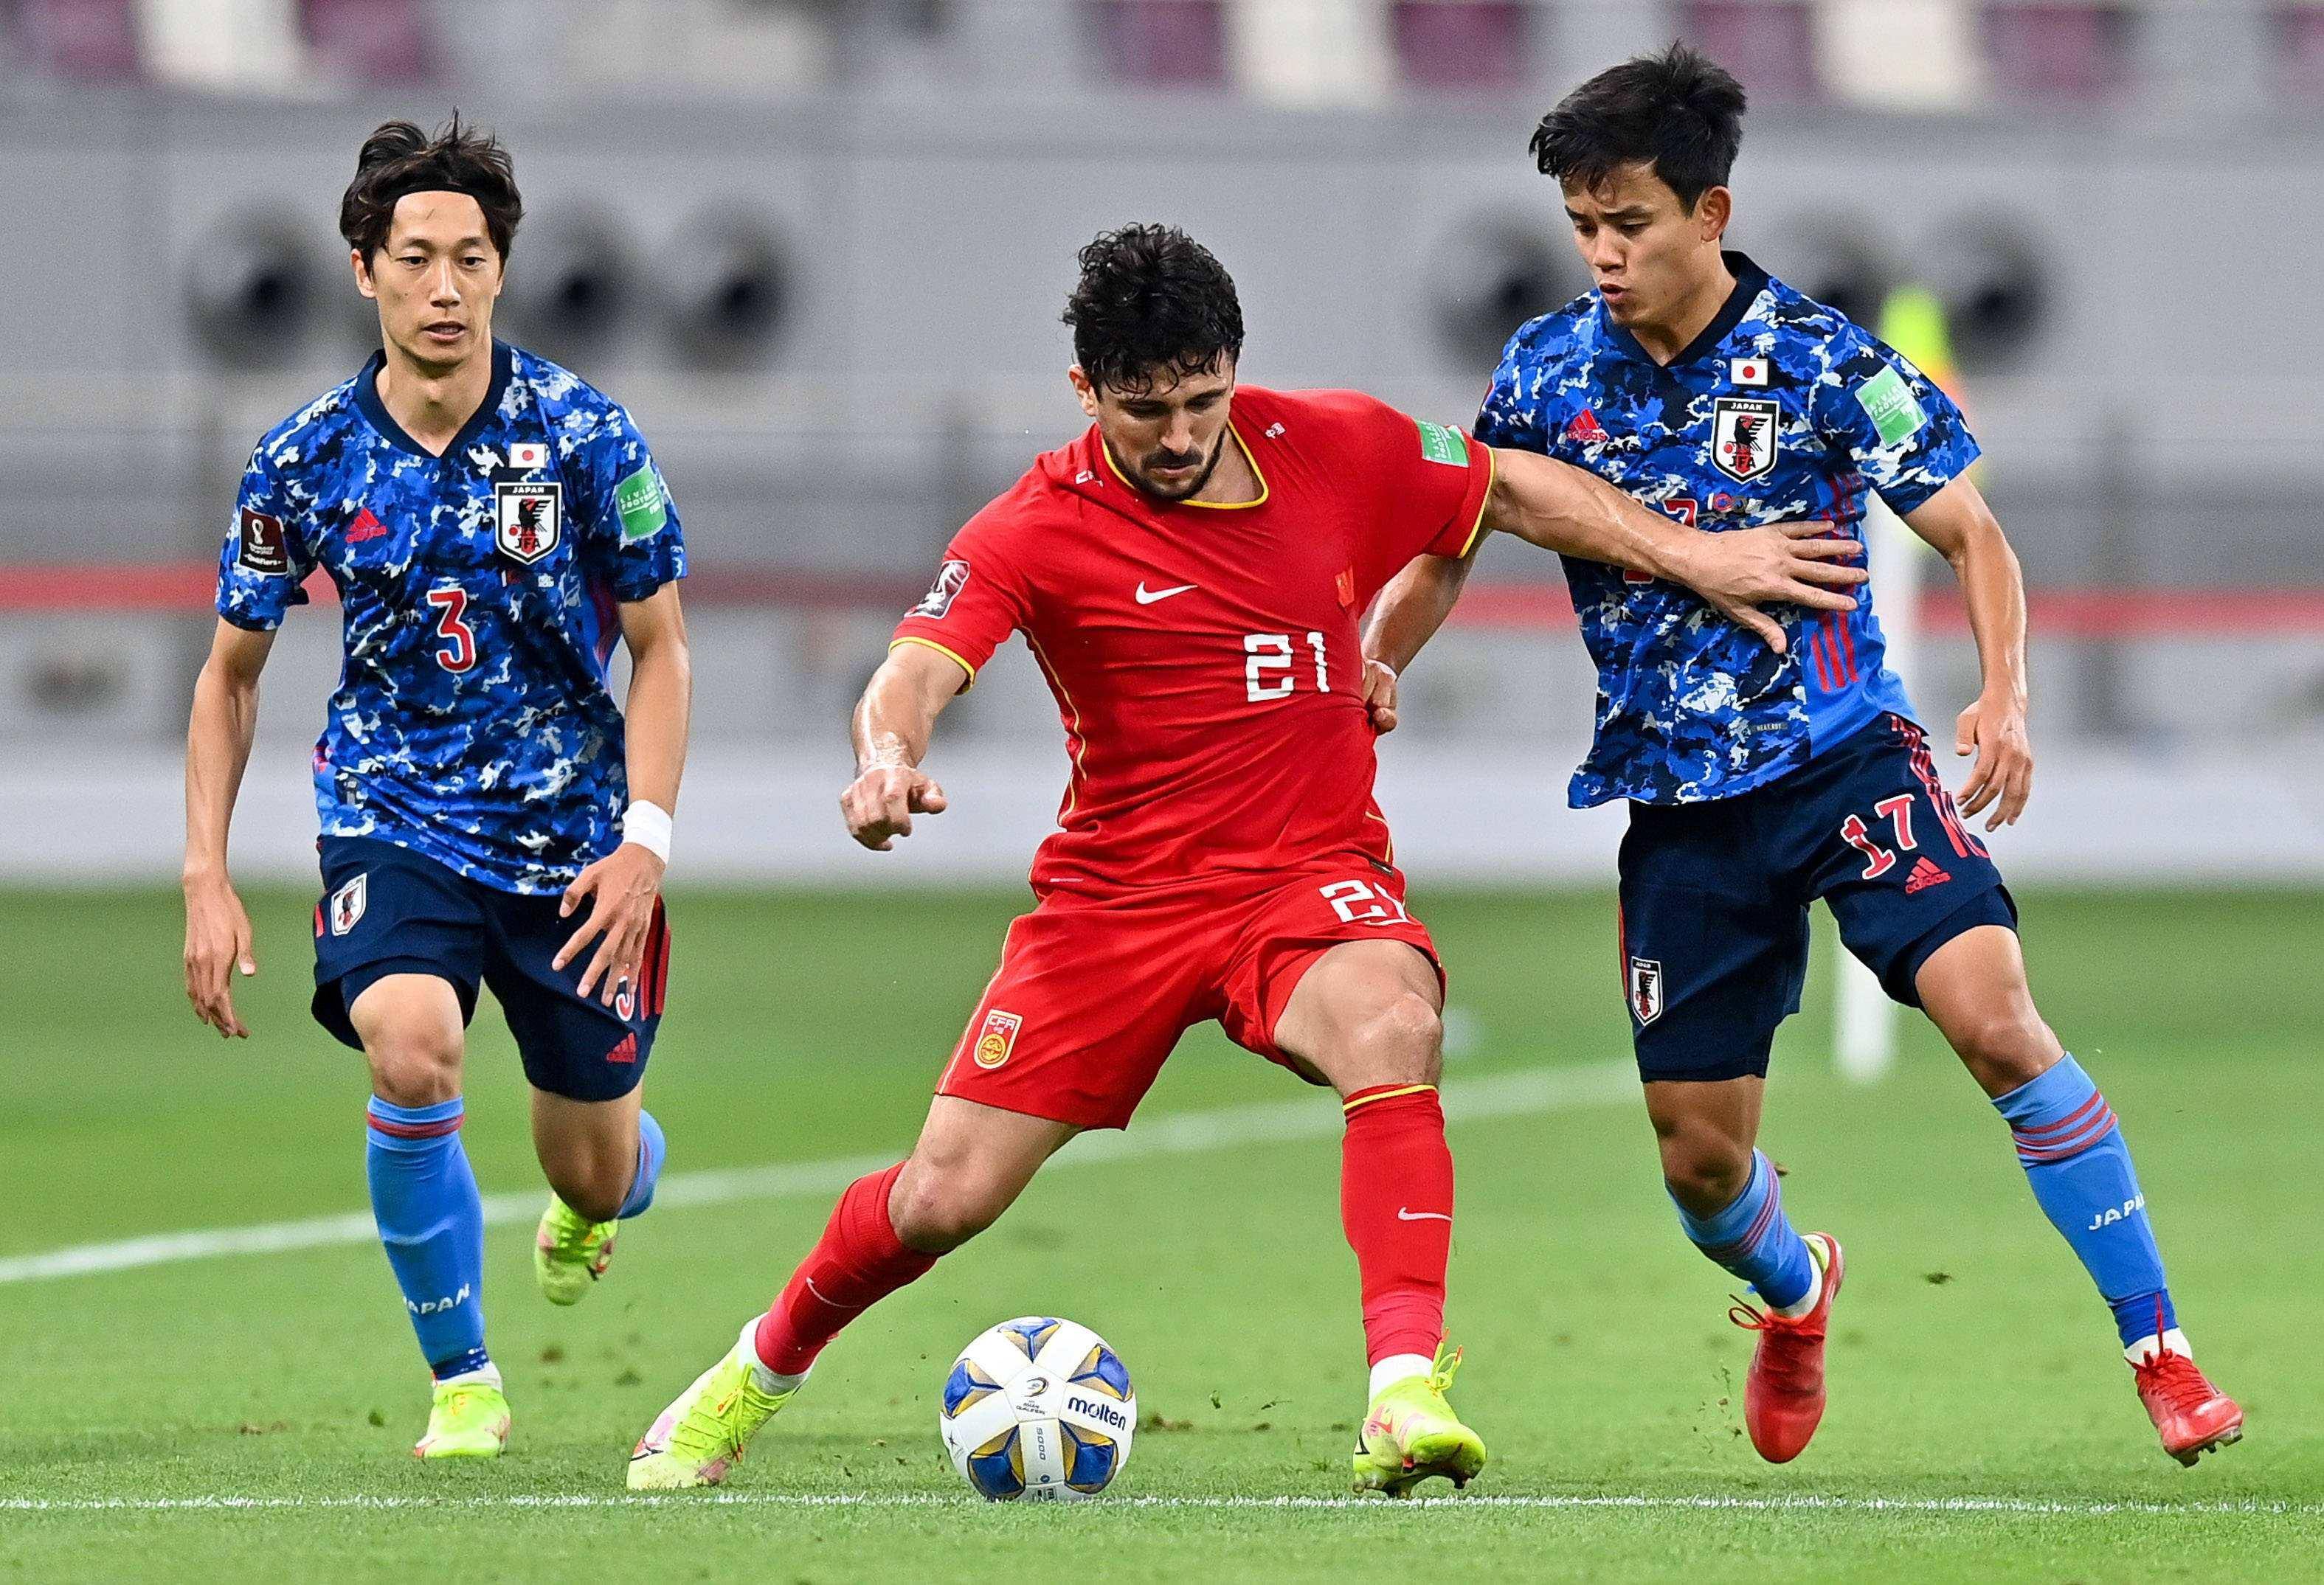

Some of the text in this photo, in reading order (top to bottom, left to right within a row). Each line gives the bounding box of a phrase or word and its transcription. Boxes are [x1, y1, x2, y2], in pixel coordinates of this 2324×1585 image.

[1731, 403, 1763, 411] JAPAN
[1567, 429, 1606, 442] adidas
[1729, 455, 1756, 468] JFA
[512, 486, 544, 494] JAPAN
[514, 537, 541, 549] JFA
[426, 588, 476, 673] 3
[1243, 631, 1330, 702] 21
[1840, 793, 1917, 880] 17
[1318, 879, 1410, 926] 21
[989, 1015, 1016, 1030] CFA
[1068, 1397, 1126, 1431] molten
